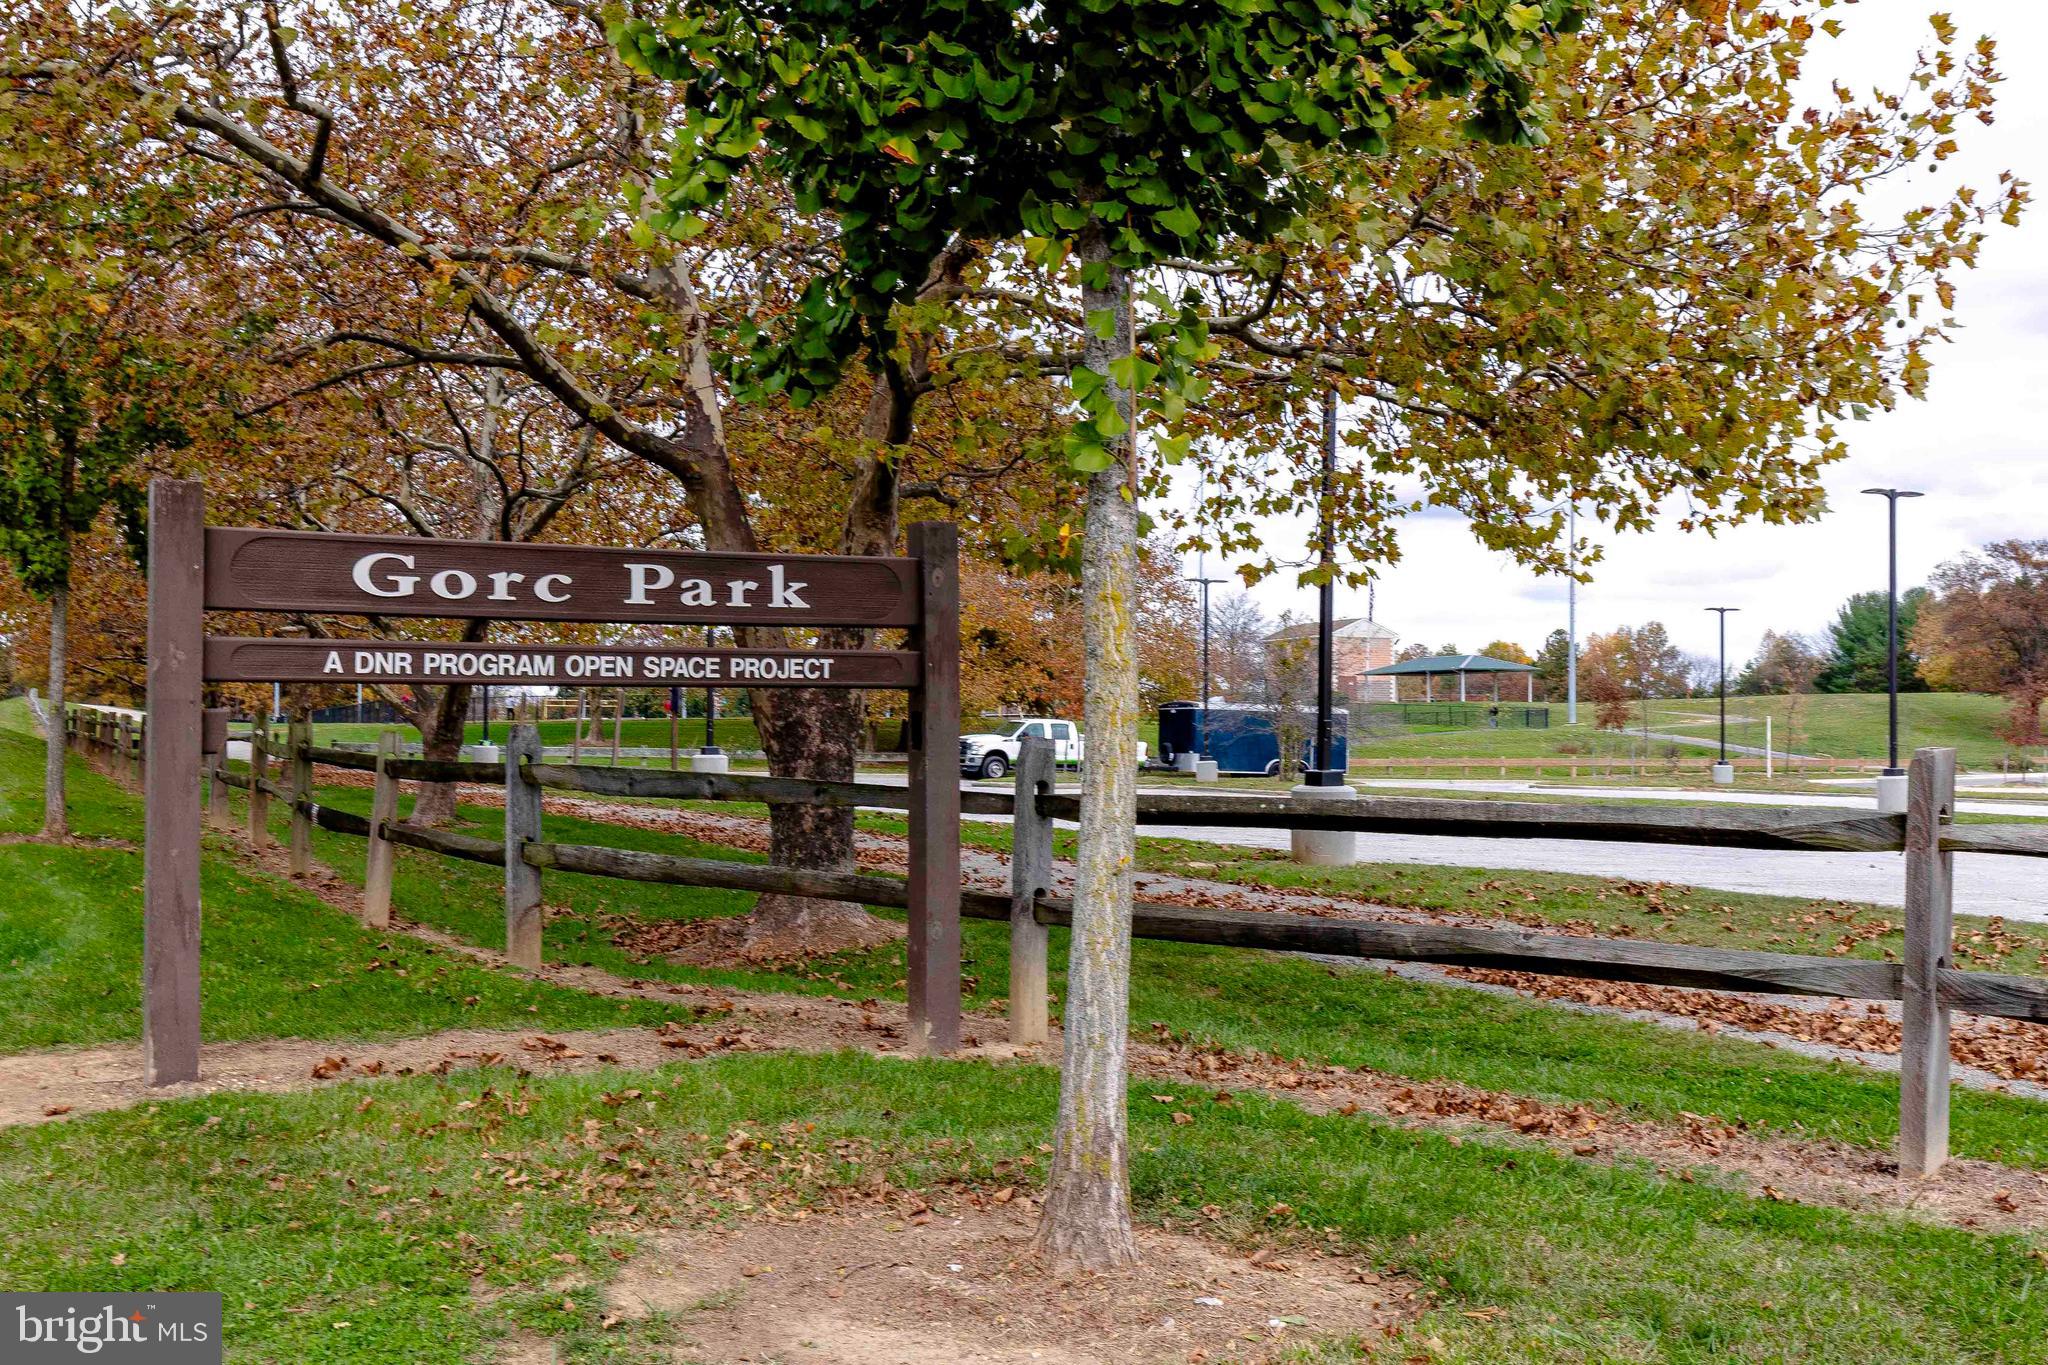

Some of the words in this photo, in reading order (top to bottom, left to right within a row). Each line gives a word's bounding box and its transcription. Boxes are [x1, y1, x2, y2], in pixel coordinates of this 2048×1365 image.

[352, 552, 573, 603] Gorc
[623, 563, 810, 609] Park
[322, 650, 344, 674] A
[354, 651, 413, 675] DNR
[423, 652, 555, 677] PROGRAM
[565, 654, 633, 677] OPEN
[643, 656, 721, 679] SPACE
[730, 657, 834, 680] PROJECT
